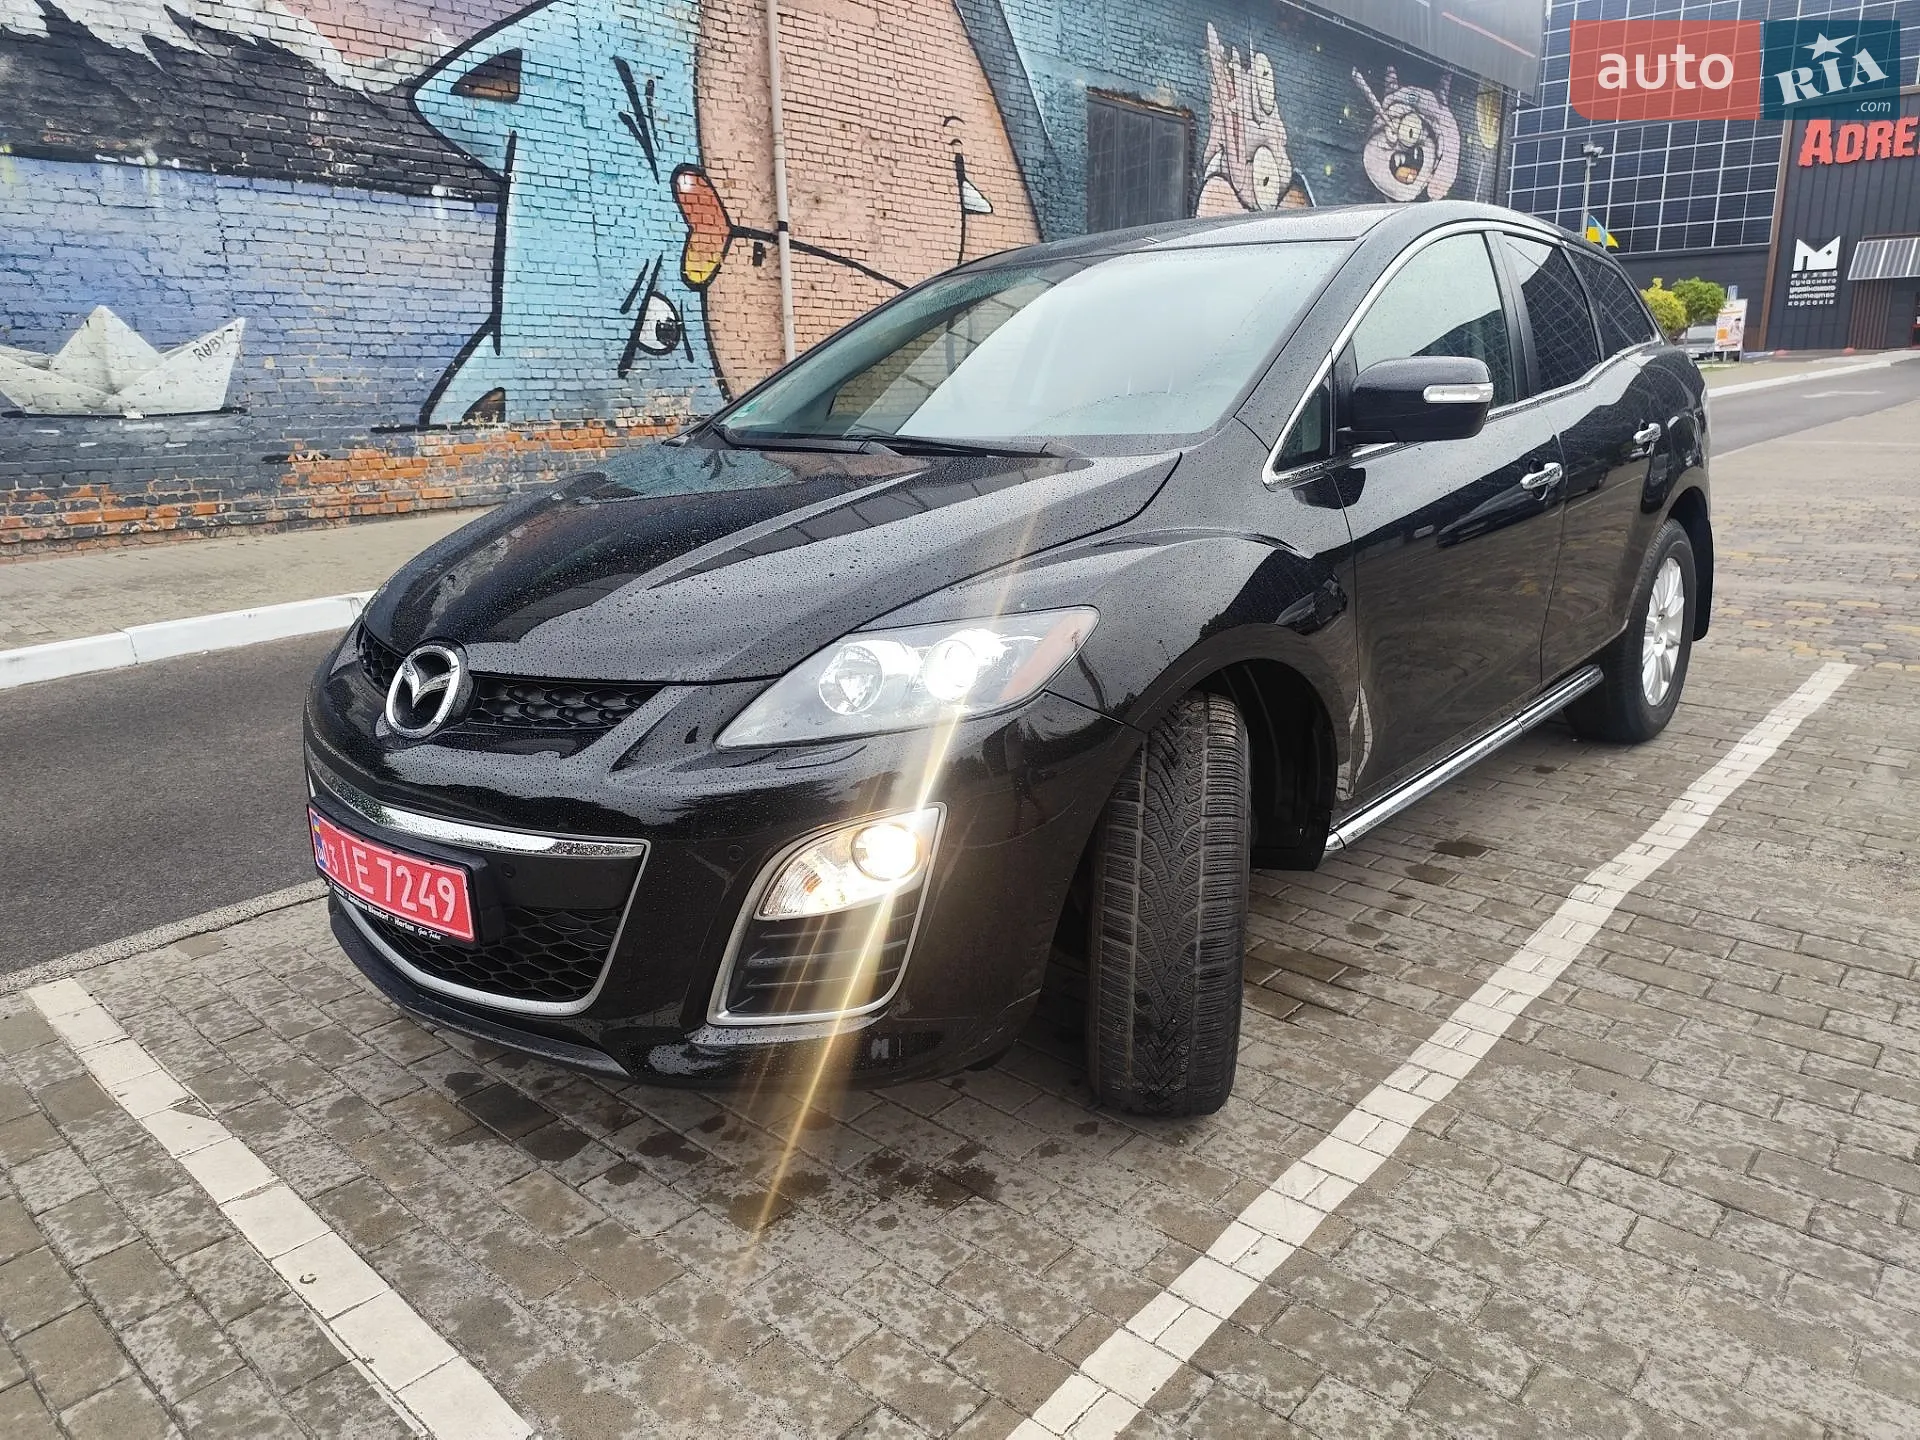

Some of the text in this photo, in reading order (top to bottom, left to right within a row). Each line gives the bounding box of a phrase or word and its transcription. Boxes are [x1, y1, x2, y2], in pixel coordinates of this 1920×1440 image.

[1797, 116, 1920, 167] ADRE
[192, 331, 225, 362] RUBY
[376, 856, 455, 922] 7249
